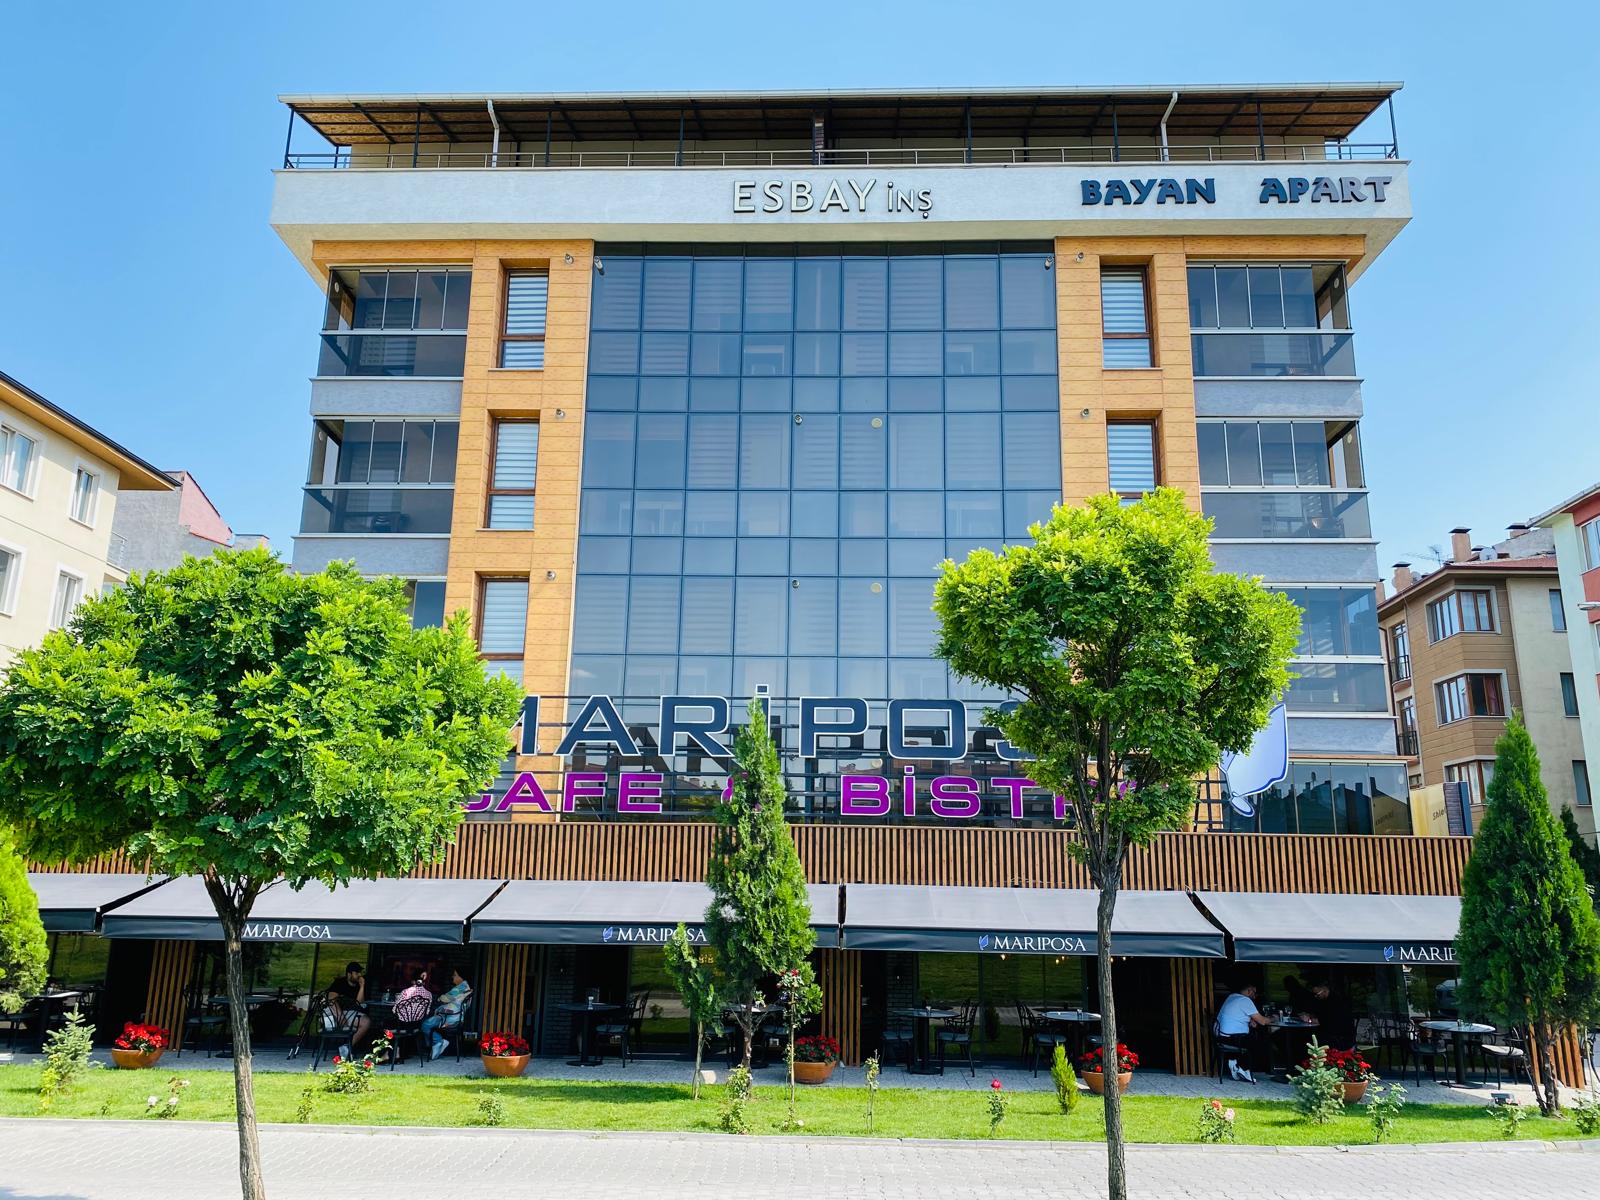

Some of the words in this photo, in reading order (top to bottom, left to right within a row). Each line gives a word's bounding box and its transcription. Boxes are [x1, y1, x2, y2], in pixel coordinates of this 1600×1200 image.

[733, 179, 876, 213] ESBAY
[1081, 177, 1216, 206] BAYAN
[1259, 176, 1393, 204] APART
[509, 684, 1047, 763] ARİPO
[840, 766, 1137, 820] BİST
[242, 924, 332, 939] MARIPOSA
[994, 935, 1087, 951] MARIPOSA
[1400, 946, 1458, 962] MARIP
